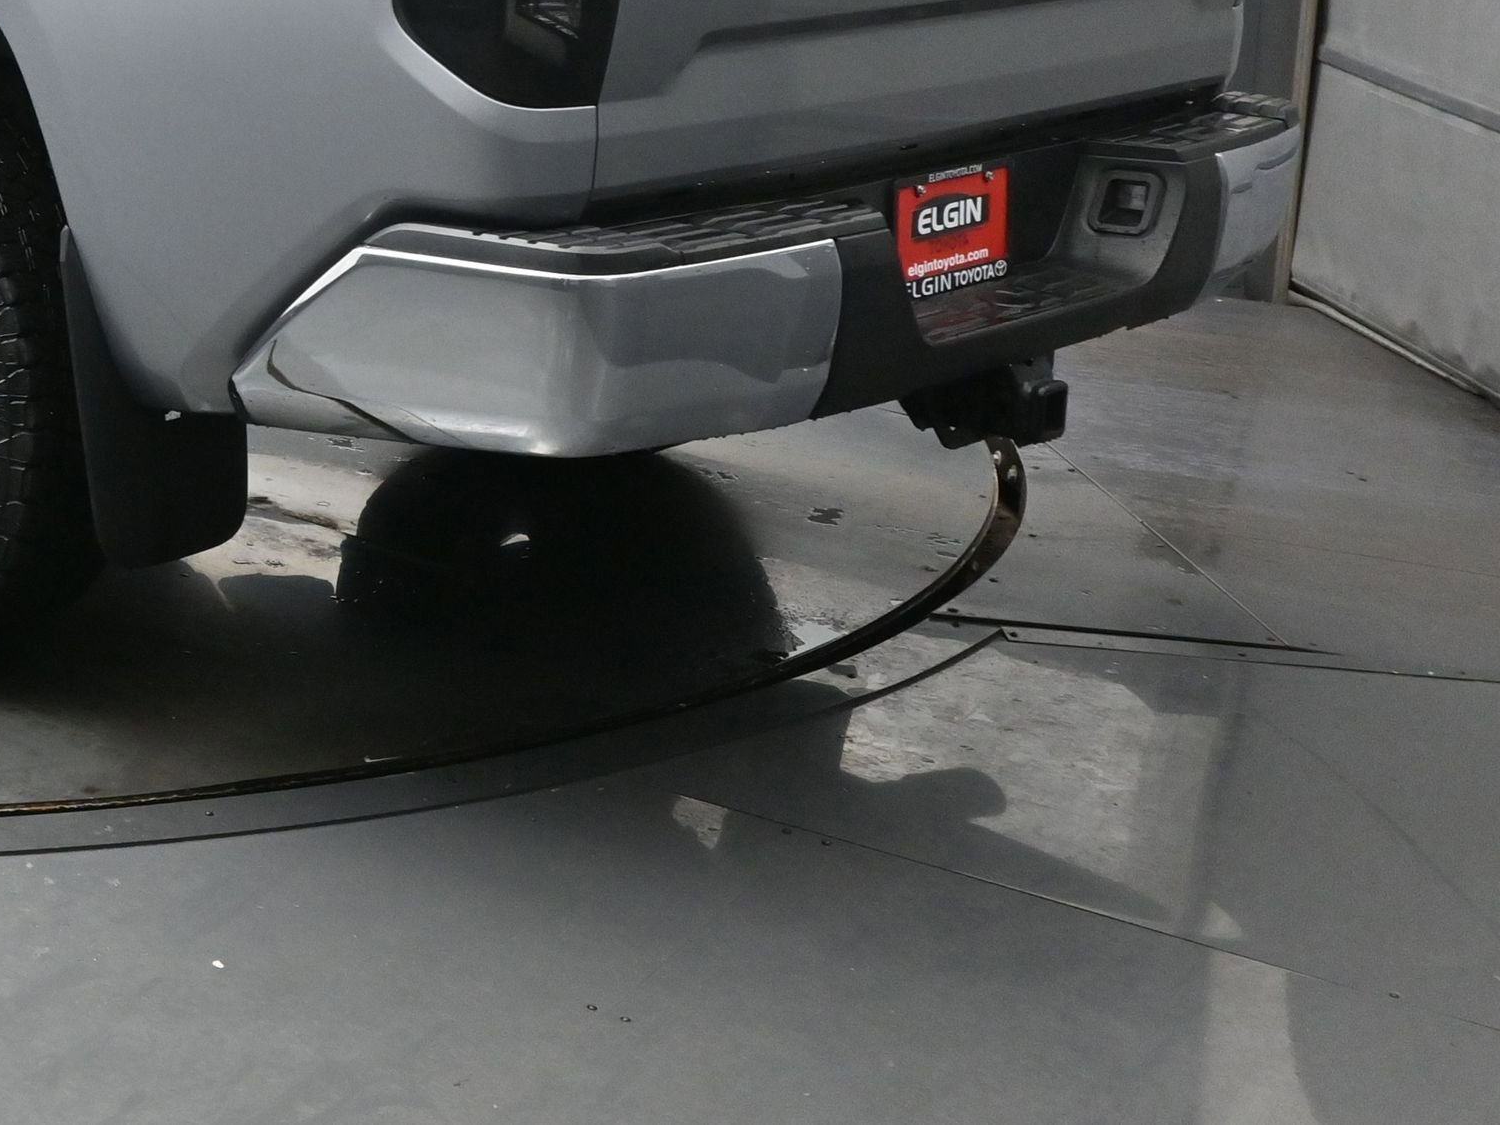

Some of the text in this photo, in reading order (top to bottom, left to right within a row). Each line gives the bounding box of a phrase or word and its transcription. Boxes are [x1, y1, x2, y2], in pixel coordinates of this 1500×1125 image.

[917, 196, 982, 235] ELGIN
[907, 248, 989, 277] elgintoyota.com
[953, 263, 995, 287] TOYOTA
